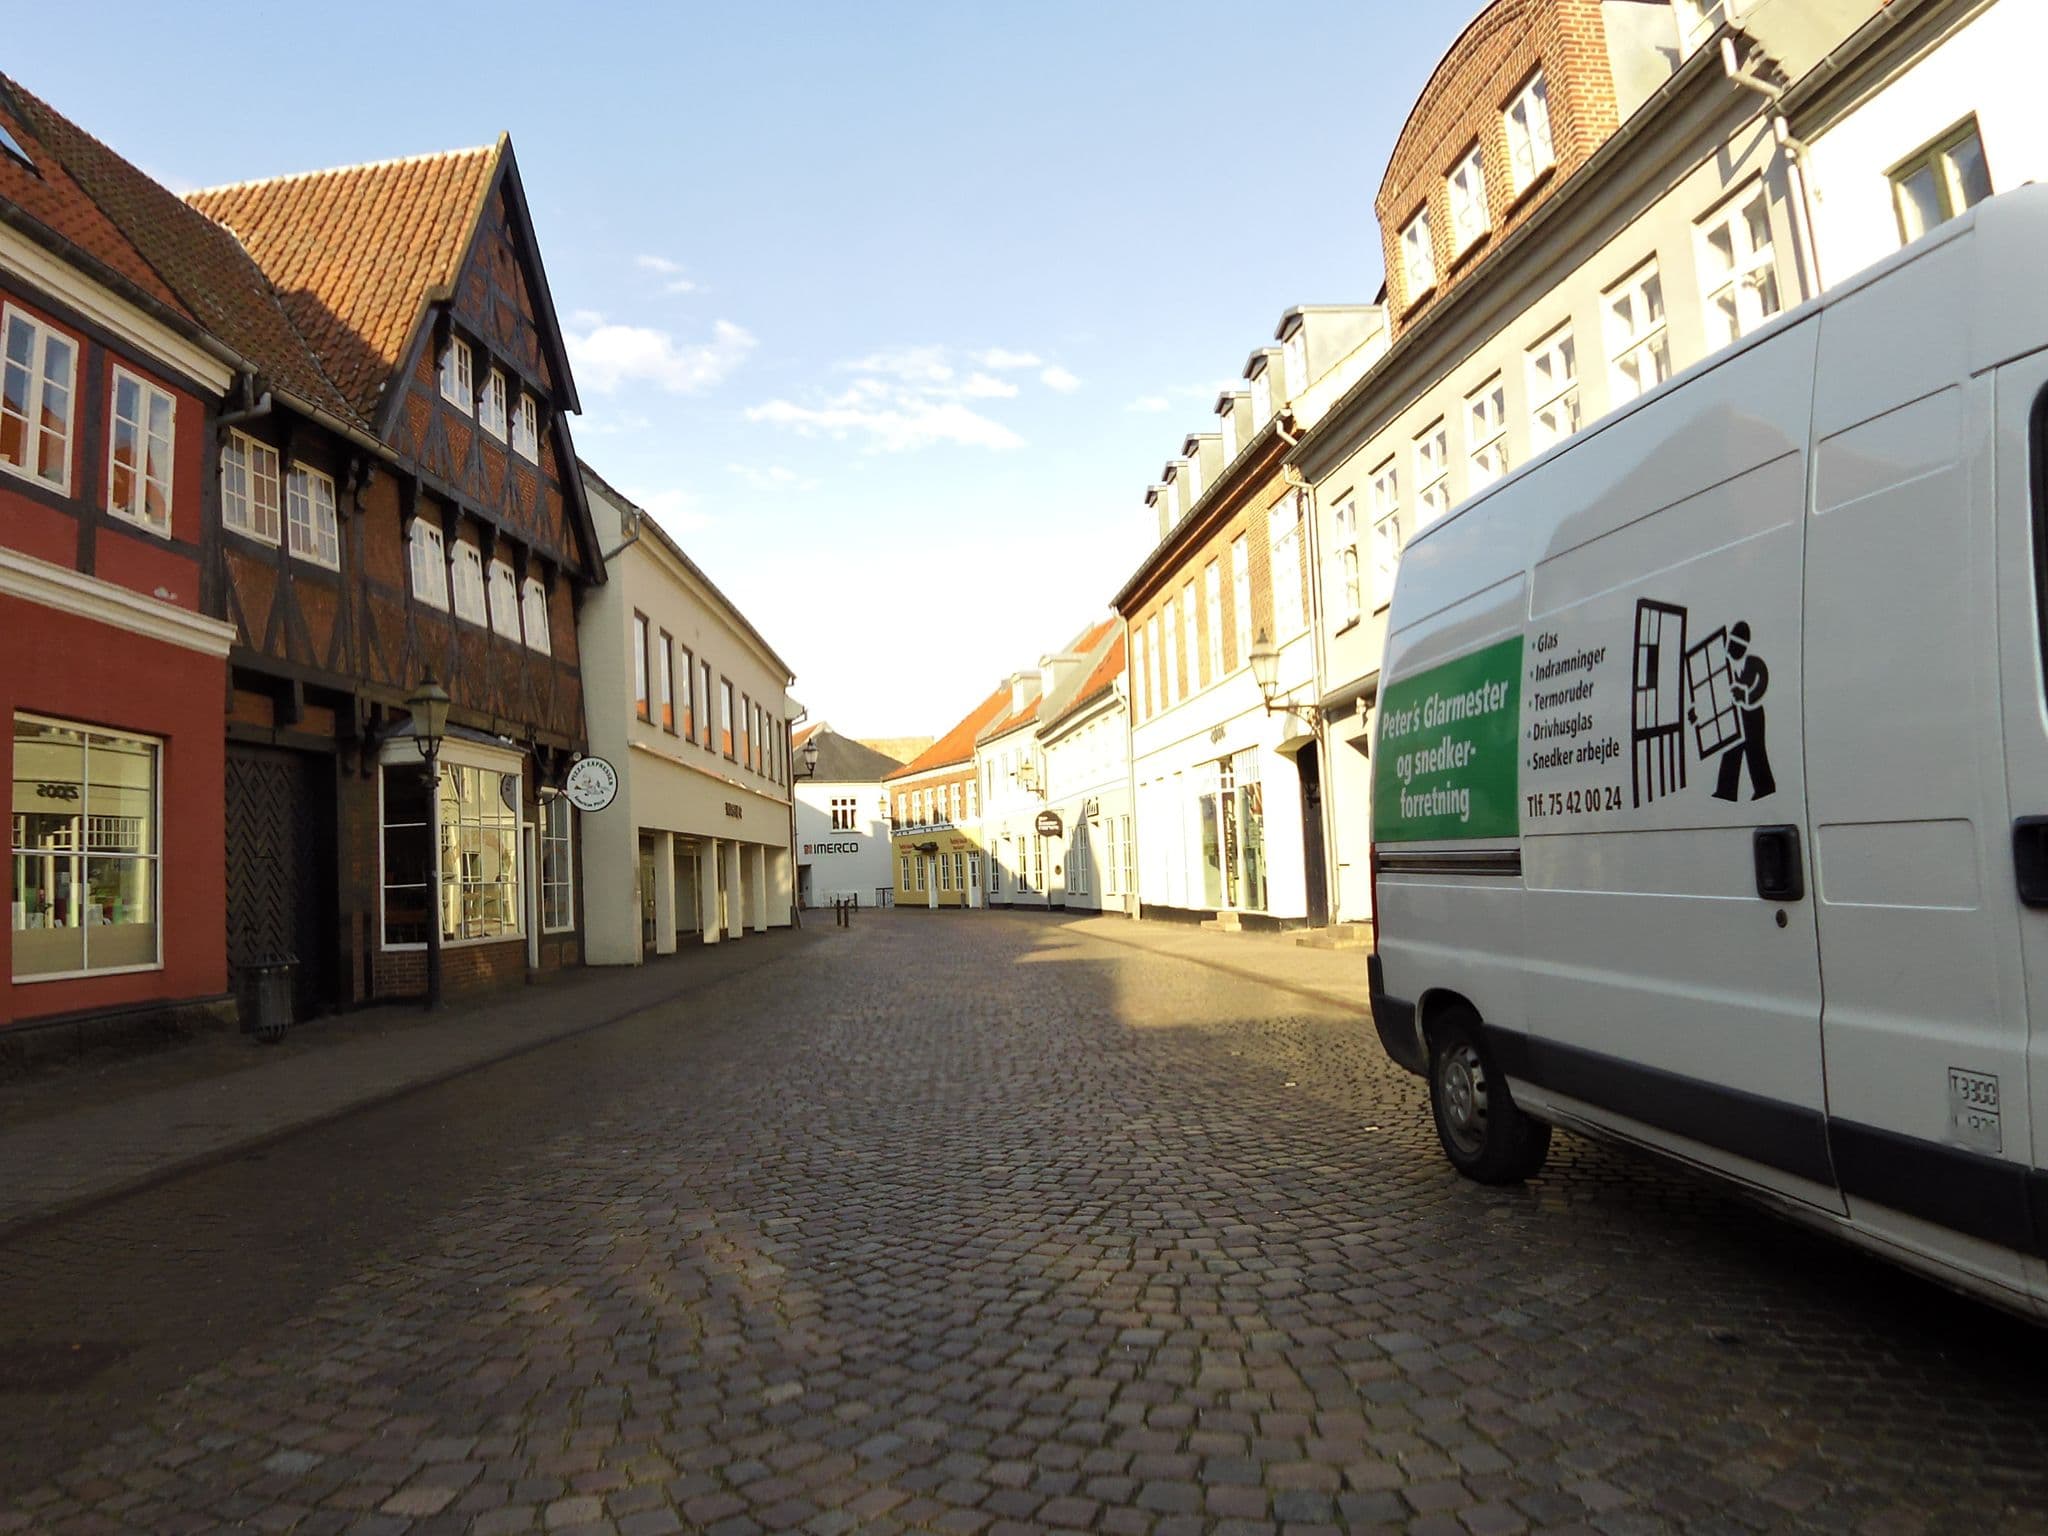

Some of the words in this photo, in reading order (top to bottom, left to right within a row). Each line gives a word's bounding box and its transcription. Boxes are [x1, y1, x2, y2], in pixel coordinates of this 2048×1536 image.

[1537, 632, 1559, 653] Glas
[1535, 646, 1606, 682] Indramninger
[1382, 700, 1420, 740] Peter's
[1423, 680, 1509, 729] Glarmester
[1534, 679, 1594, 711] Termoruder
[1533, 712, 1593, 741] Drivhusglas
[1396, 753, 1412, 785] og
[1414, 735, 1476, 775] snedker-
[1532, 746, 1574, 770] Snedker
[1576, 736, 1620, 765] arbejde
[1400, 780, 1470, 823] forretning
[1527, 793, 1546, 817] Tlf.
[1548, 792, 1563, 816] 75
[1566, 789, 1582, 814] 42
[1585, 787, 1601, 812] 00
[1604, 785, 1622, 811] 24
[813, 842, 859, 855] IMERCO
